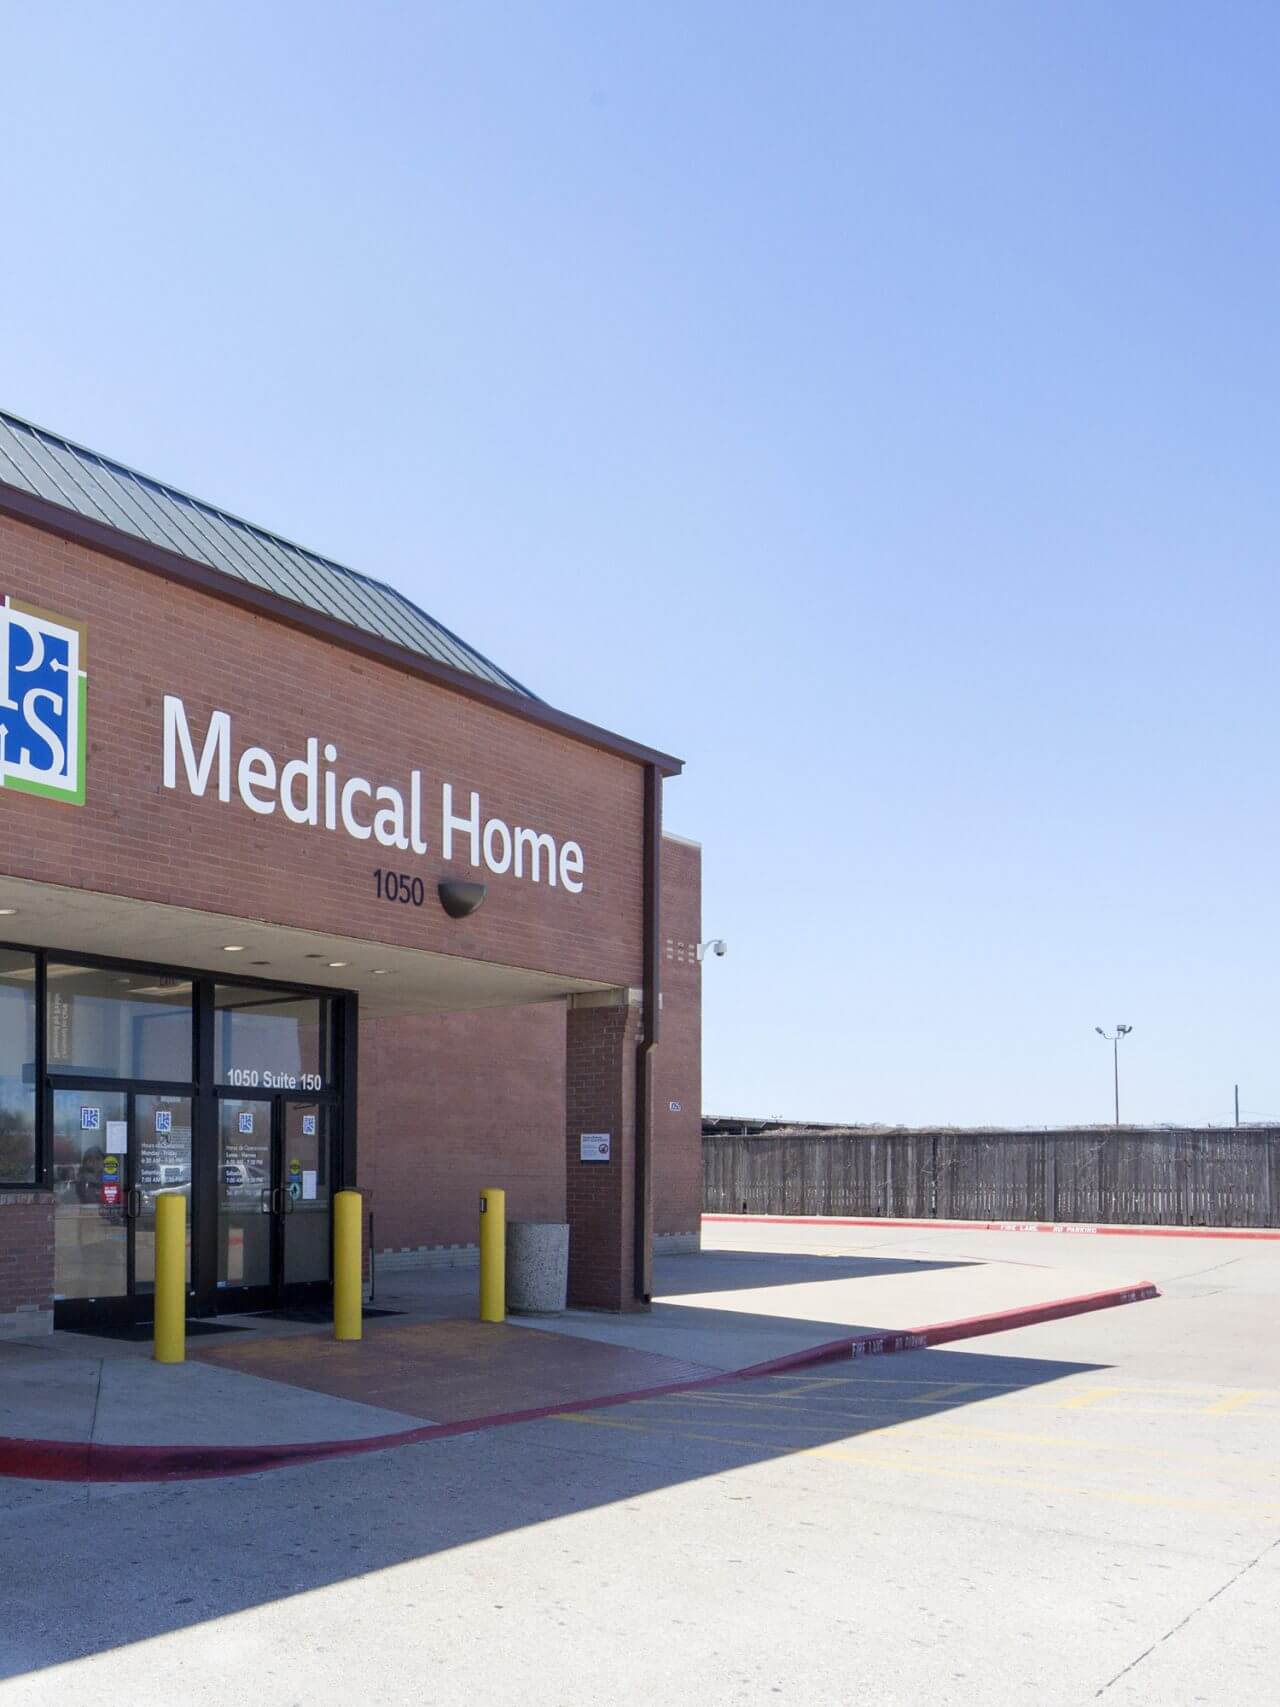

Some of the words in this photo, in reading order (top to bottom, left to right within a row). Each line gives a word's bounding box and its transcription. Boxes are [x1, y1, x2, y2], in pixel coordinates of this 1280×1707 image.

[162, 694, 428, 855] Medical
[441, 782, 585, 894] Home
[372, 868, 425, 906] 1050
[227, 1068, 259, 1087] 1050
[263, 1070, 297, 1089] Suite
[301, 1073, 322, 1091] 150
